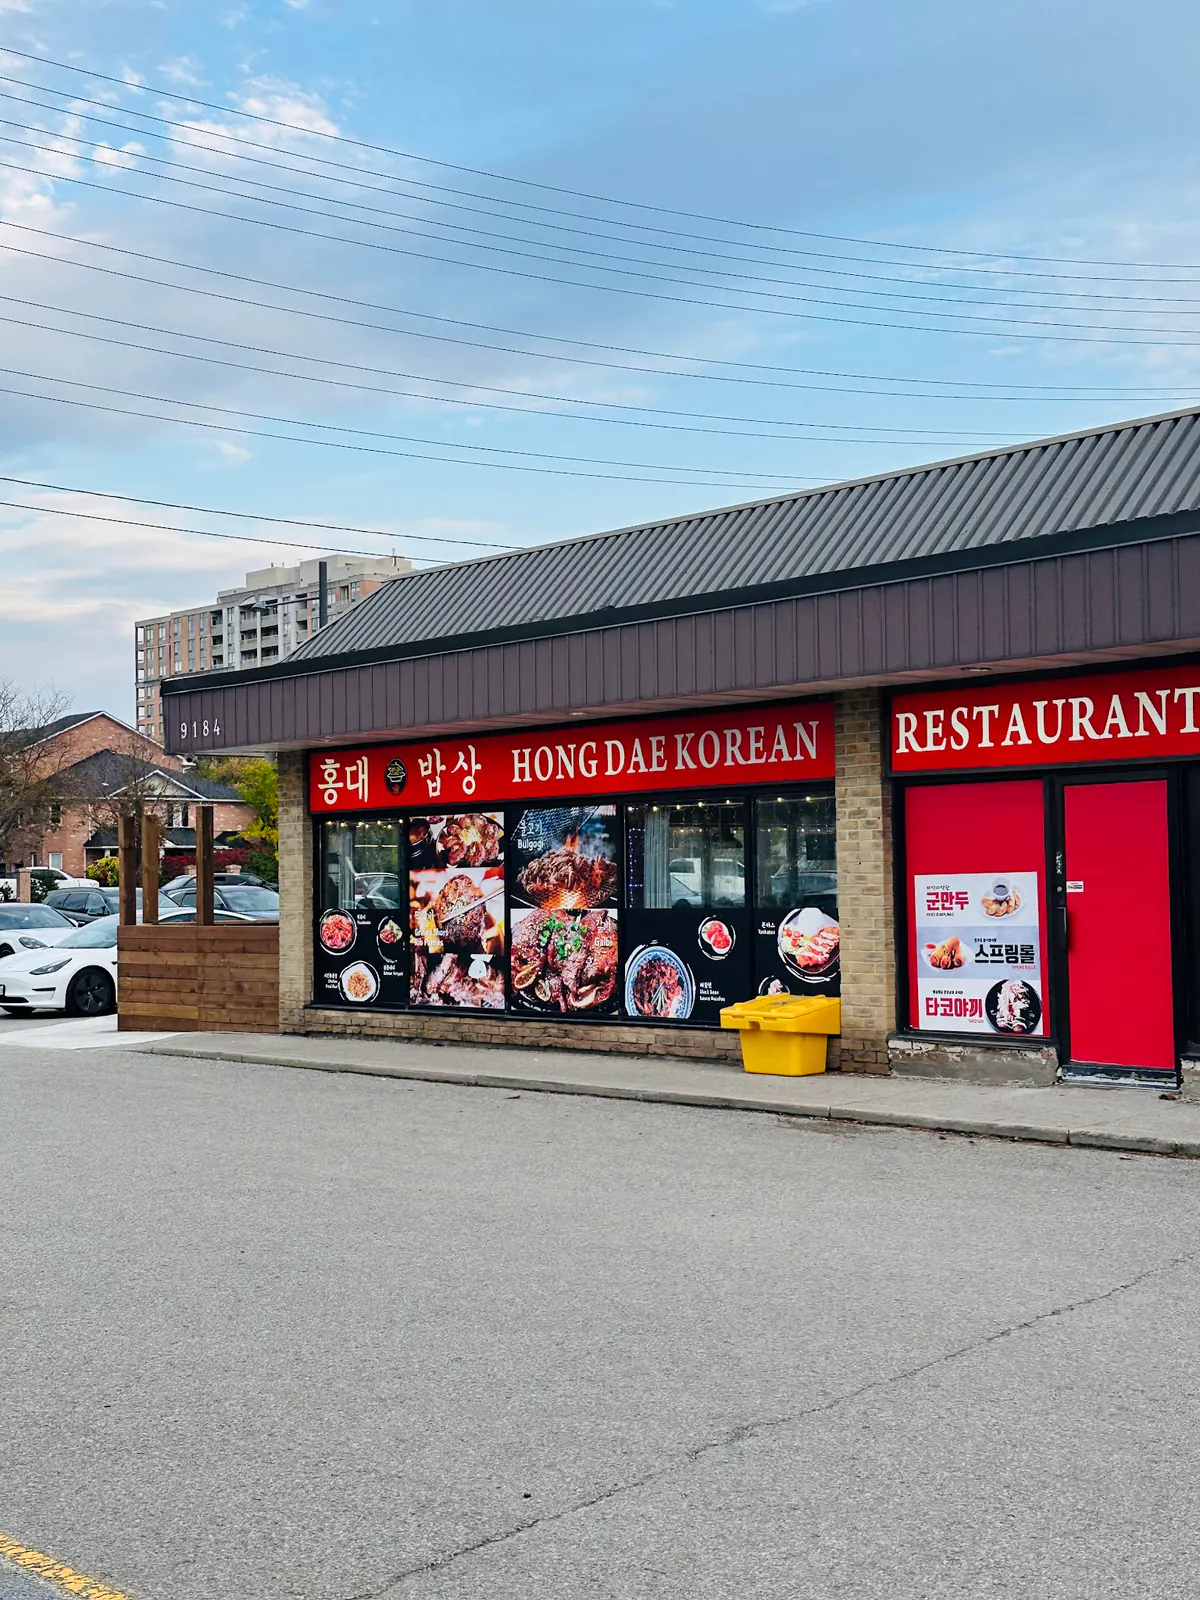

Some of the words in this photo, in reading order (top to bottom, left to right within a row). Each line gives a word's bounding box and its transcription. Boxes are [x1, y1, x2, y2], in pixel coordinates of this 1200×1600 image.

[181, 719, 220, 738] 9184
[896, 686, 1200, 754] RESTAURANT
[512, 742, 597, 783] HONG
[604, 735, 667, 775] DAE
[674, 721, 819, 770] KOREAN
[318, 756, 368, 804] 홍대
[418, 745, 481, 797] 밥상
[517, 839, 544, 850] Bulgogi
[926, 891, 969, 911] 군만두
[595, 937, 613, 946] Galbi
[974, 944, 1035, 964] 스프링롤
[925, 997, 983, 1018] 타코야끼
